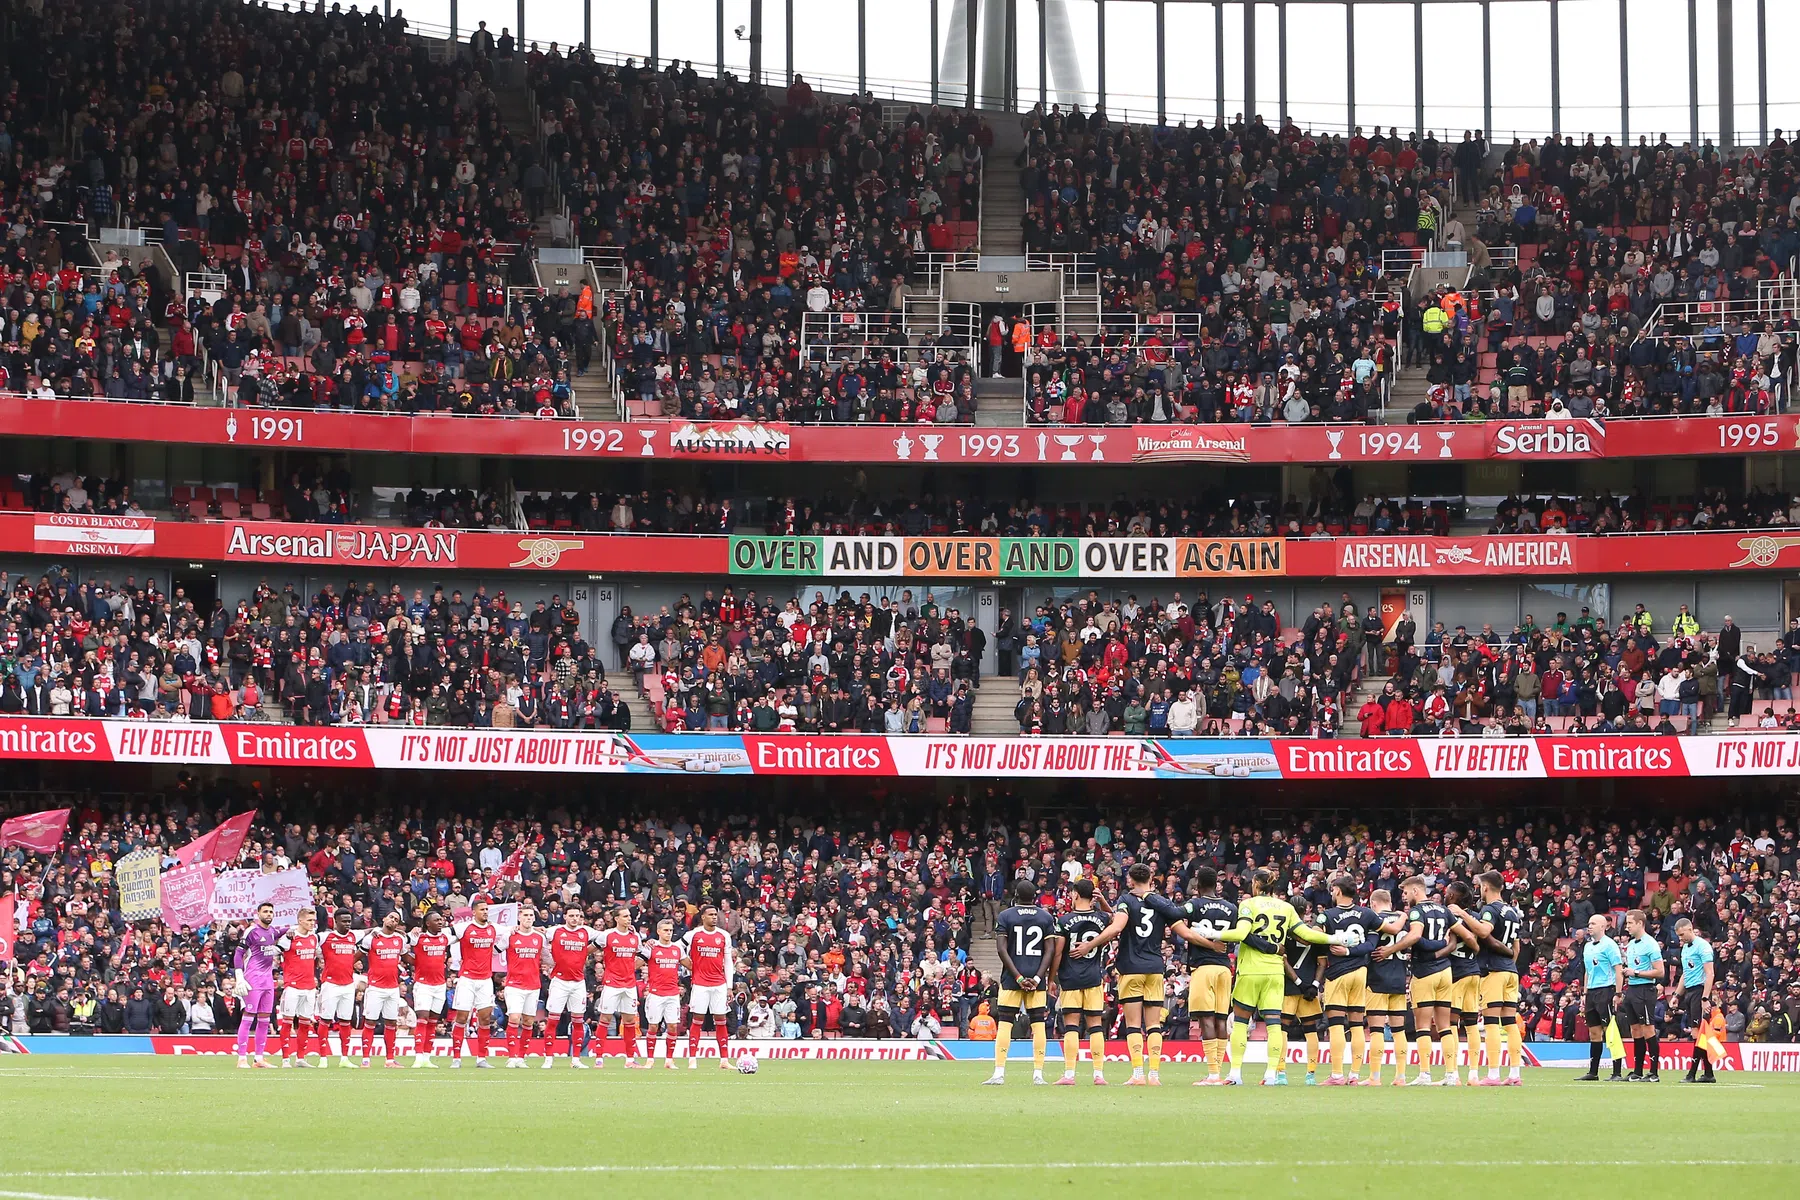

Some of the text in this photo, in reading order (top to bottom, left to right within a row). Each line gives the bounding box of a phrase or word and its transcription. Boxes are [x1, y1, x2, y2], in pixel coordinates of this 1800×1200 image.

[557, 268, 567, 276] 104
[997, 275, 1008, 283] 105
[1438, 271, 1449, 279] 106
[251, 416, 303, 441] 1991
[562, 428, 624, 452] 1992
[1496, 425, 1591, 454] Serbia
[1718, 422, 1779, 447] 1995
[673, 439, 788, 455] AUSTRIA SC
[959, 434, 1020, 457] 1993
[1137, 436, 1245, 451] Mizoram Arsenal
[1359, 432, 1422, 455] 1994
[50, 515, 139, 528] COSTA BLANCA
[67, 544, 122, 554] ARSENAL
[228, 526, 457, 562] Arsenal JAPAN
[734, 539, 1281, 572] OVER AND OVER AND OVER AGAIN
[1342, 540, 1572, 568] ARSENAL AMERICA
[576, 590, 587, 601] 54
[601, 590, 612, 601] 54
[981, 595, 992, 606] 55
[1412, 594, 1424, 605] 56
[119, 727, 213, 757] FLY BETTER
[237, 731, 357, 761] Emirates
[400, 736, 431, 762] IT'S
[435, 736, 467, 763] NOT
[468, 737, 513, 764] JUST
[515, 738, 574, 765] ABOUT
[574, 739, 605, 766] THE
[1716, 740, 1800, 768] IT'S NOT J
[697, 752, 741, 762] Emirates
[757, 740, 881, 770] Emirates
[926, 743, 957, 769] IT'S
[962, 743, 994, 769] NOT
[996, 743, 1042, 770] JUST
[1043, 743, 1102, 770] ABOUT
[1104, 744, 1133, 771] THE
[1226, 757, 1270, 767] Emirates
[1288, 742, 1412, 772] Emirates
[1435, 744, 1529, 772] FLY BETTER
[1553, 741, 1672, 770] Emirates
[1017, 908, 1038, 916] DIOUF
[1135, 907, 1154, 938] 3
[1014, 925, 1042, 956] 12
[1253, 913, 1286, 943] 23
[1293, 940, 1312, 970] 7
